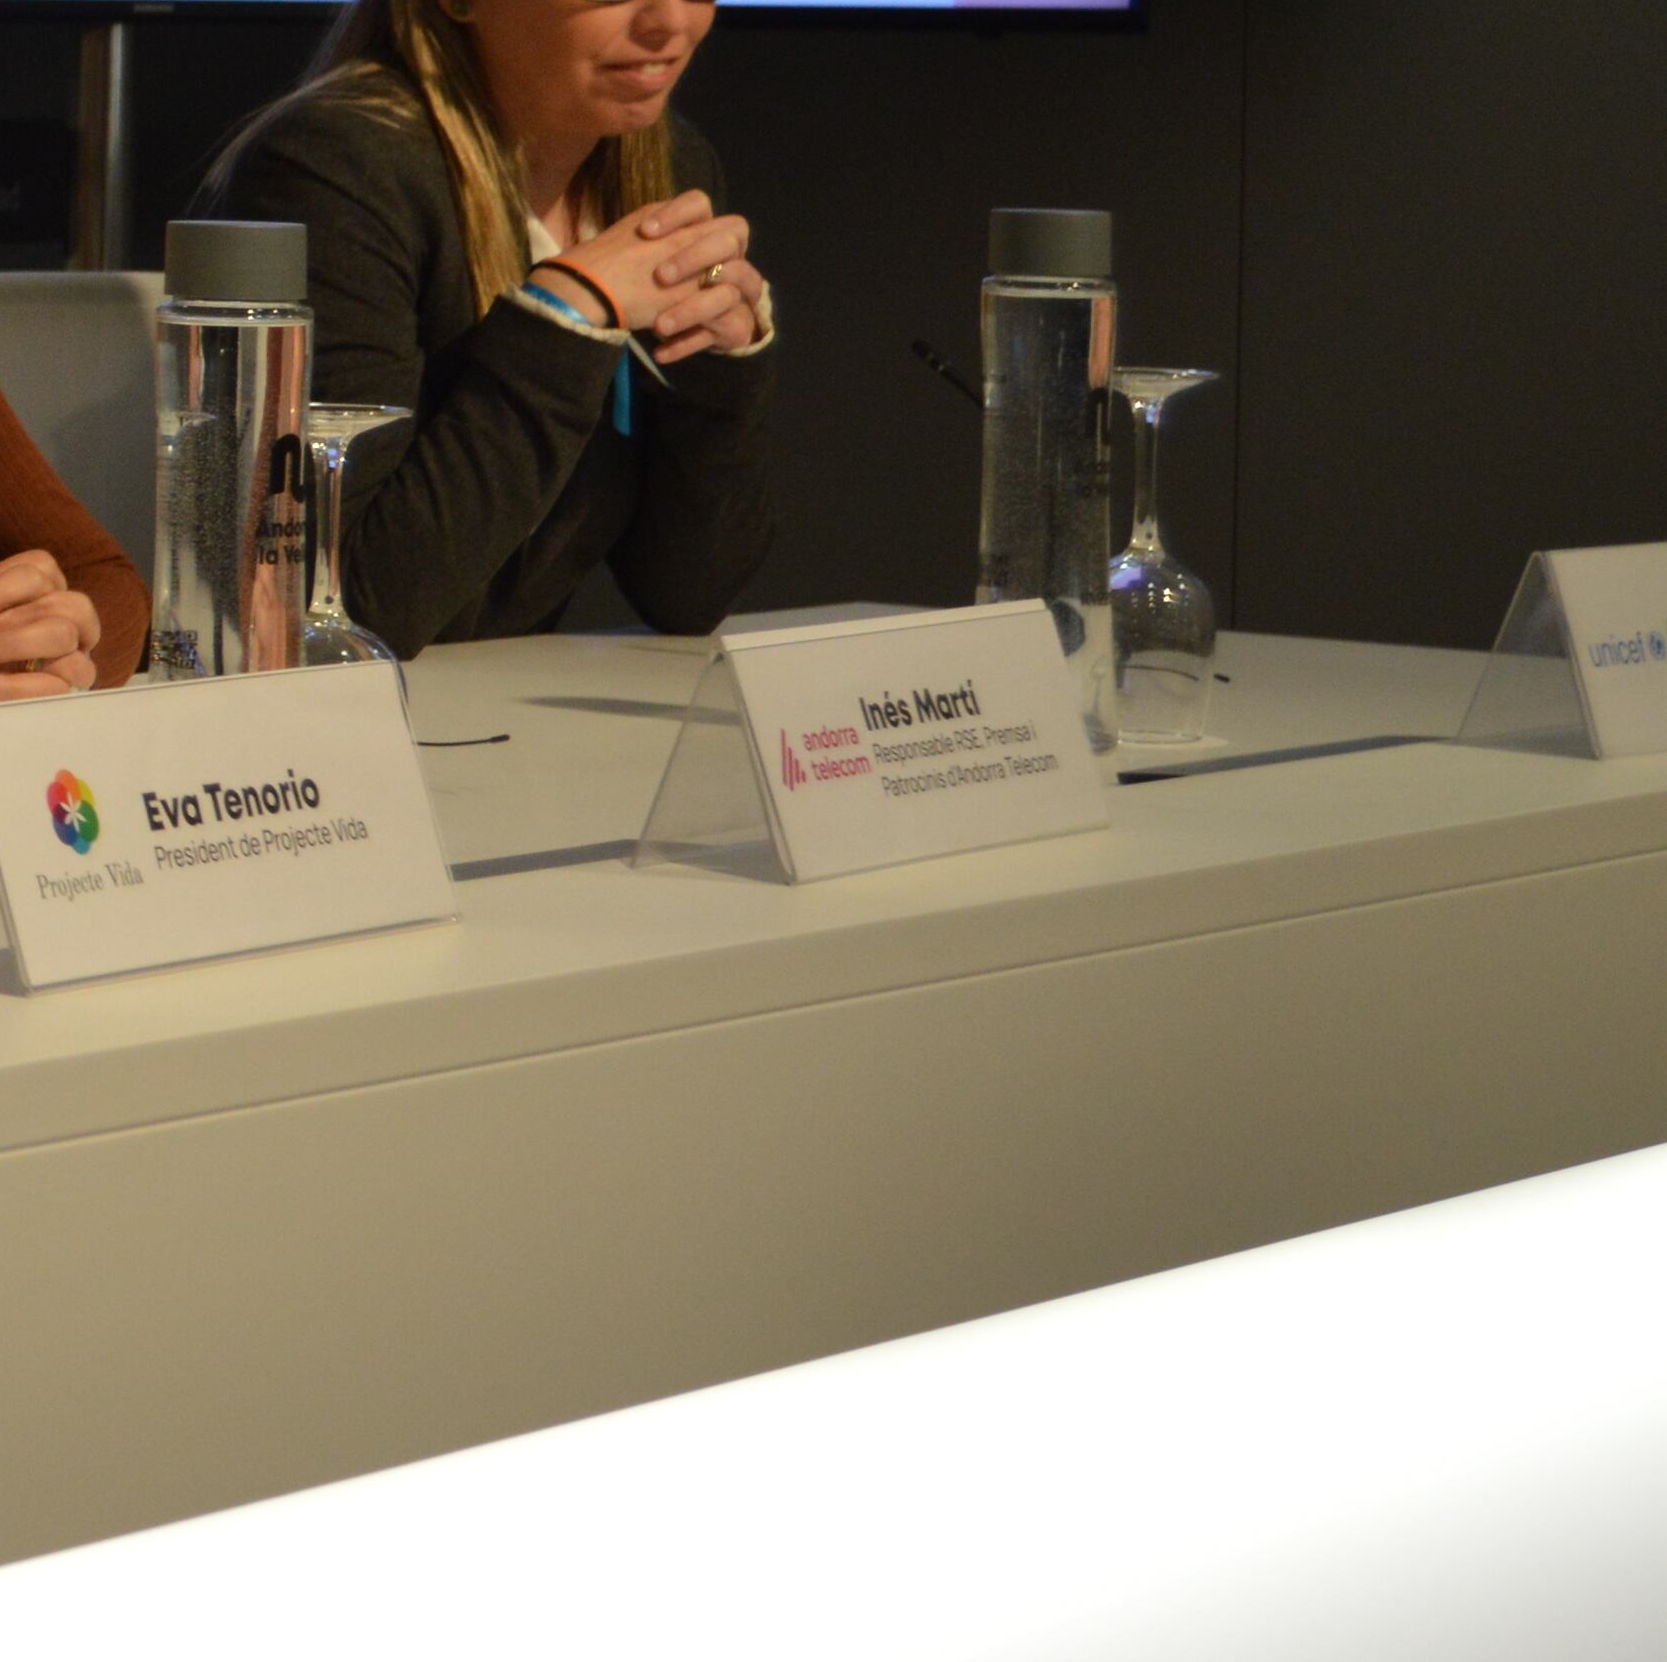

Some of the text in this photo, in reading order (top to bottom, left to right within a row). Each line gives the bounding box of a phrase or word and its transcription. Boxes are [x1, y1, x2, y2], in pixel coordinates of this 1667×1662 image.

[858, 690, 912, 731] Inés
[801, 724, 860, 752] andorra
[872, 735, 954, 767] Responsable
[810, 753, 872, 782] telecom
[1003, 752, 1060, 778] Telecom
[142, 768, 320, 831] Eva Tenorio
[154, 815, 369, 870] President de Projecte Vida
[36, 859, 144, 902] Projecte Vida
